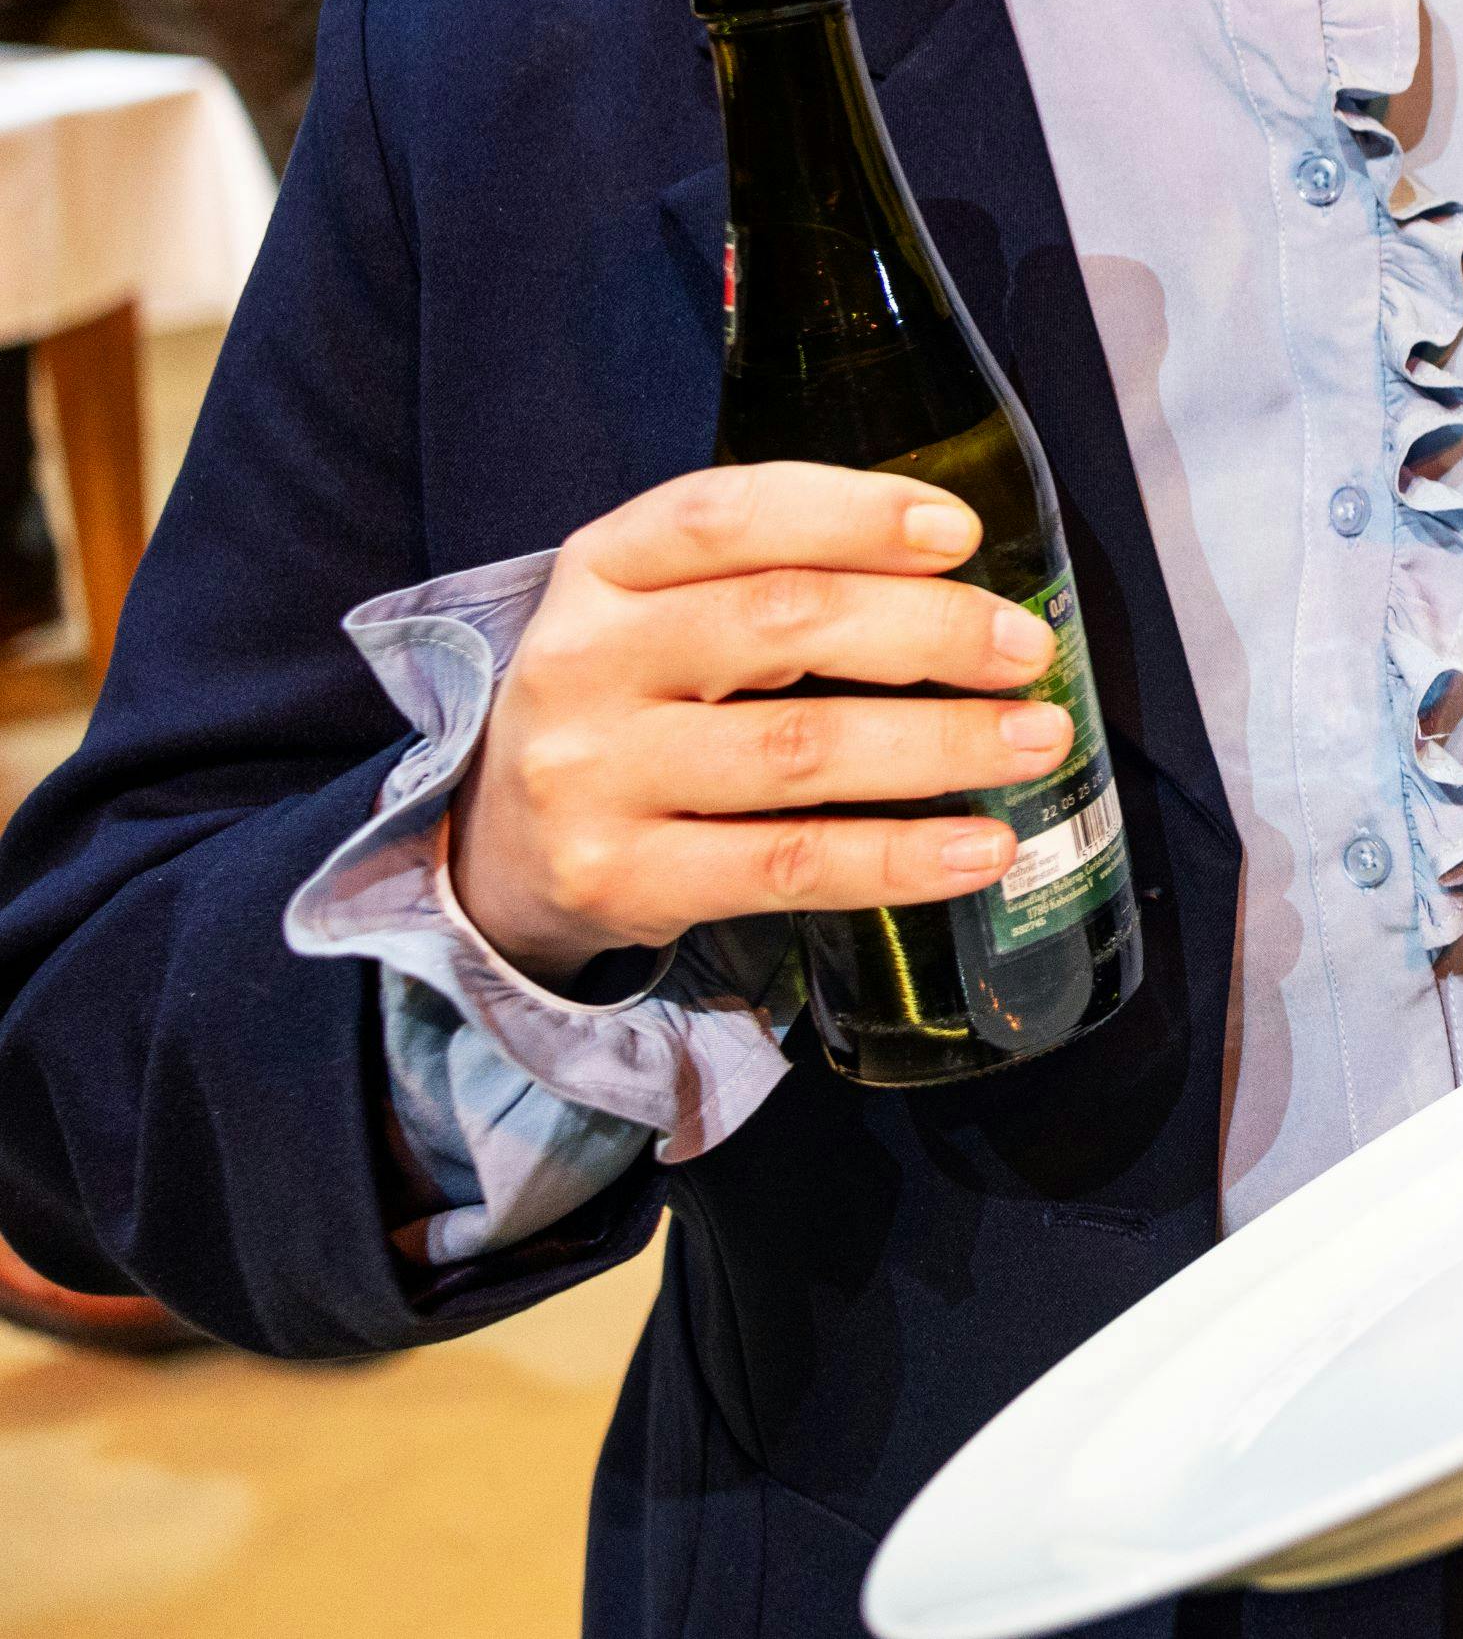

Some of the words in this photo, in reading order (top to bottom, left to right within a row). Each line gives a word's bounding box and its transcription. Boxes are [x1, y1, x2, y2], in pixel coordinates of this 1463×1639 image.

[1043, 804, 1058, 821] 22
[1061, 794, 1075, 810] 05
[1078, 783, 1091, 799] 25
